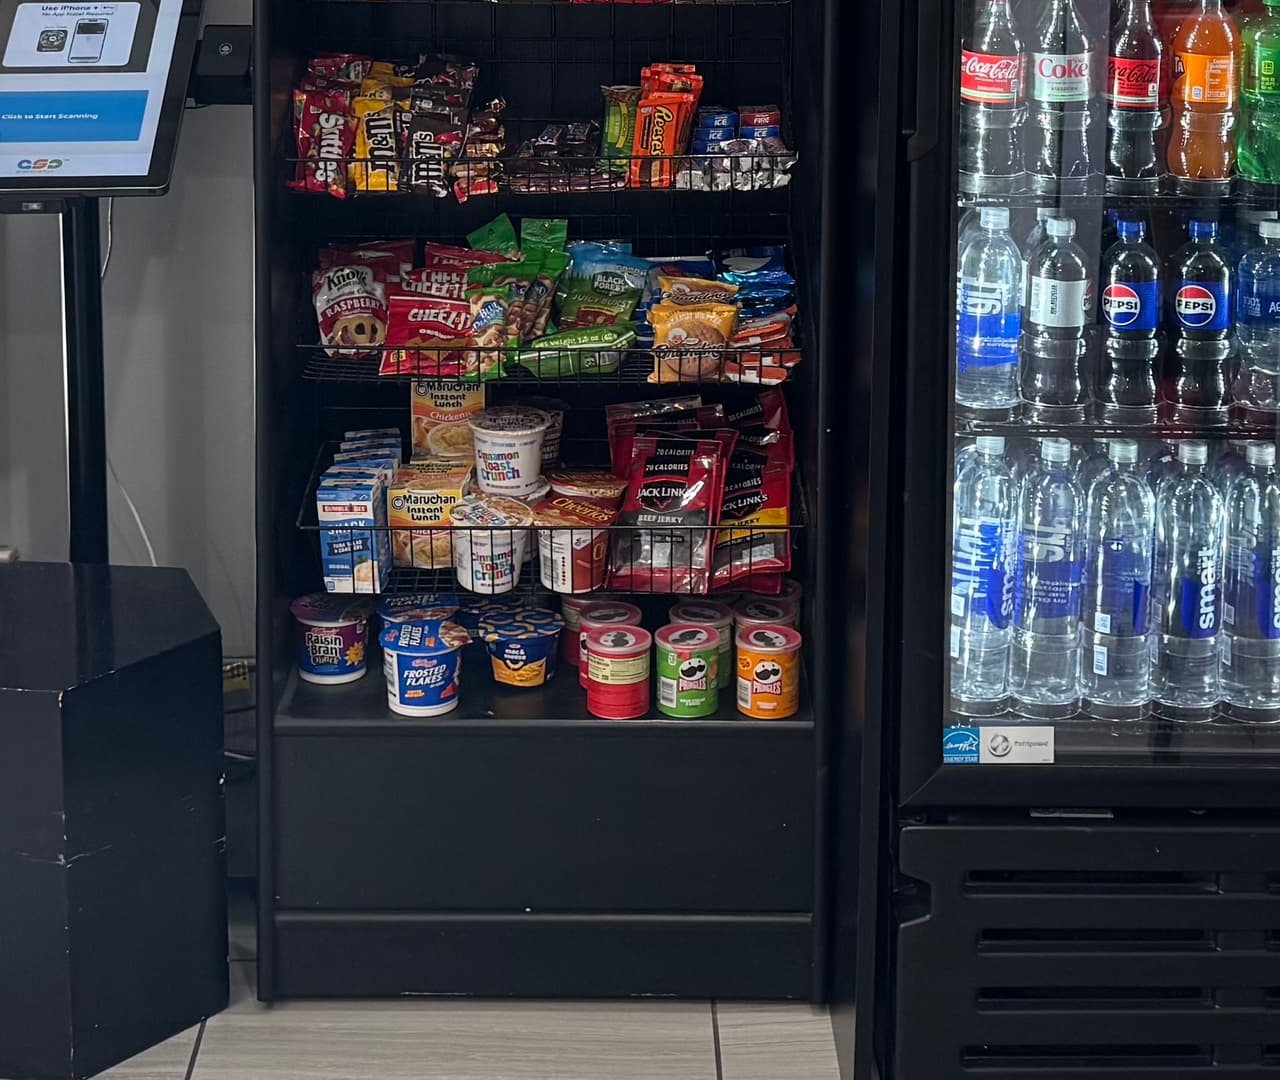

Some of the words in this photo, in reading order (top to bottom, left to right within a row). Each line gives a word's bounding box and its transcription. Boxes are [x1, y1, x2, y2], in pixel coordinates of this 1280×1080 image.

[1038, 57, 1089, 80] Coke
[714, 117, 728, 127] ICE
[709, 130, 723, 140] ICE
[754, 128, 769, 138] ICE
[597, 274, 625, 286] BLACK
[594, 282, 627, 292] FOREST
[572, 293, 602, 304] JUICY
[326, 297, 381, 318] RASPBERRY
[1103, 299, 1138, 311] PEPSI
[1177, 299, 1214, 312] PEPSI
[430, 392, 466, 401] Instant
[434, 400, 463, 408] Lunch
[477, 449, 519, 460] Cinnamon
[485, 459, 513, 471] Toast
[481, 468, 520, 483] Crunch
[403, 494, 456, 505] Maruchan
[407, 506, 444, 514] Instant
[552, 498, 613, 521] Cheerios
[411, 513, 440, 521] Lunch
[1198, 546, 1217, 630] smart
[306, 633, 343, 647] Raisin
[309, 645, 338, 657] Bran
[404, 665, 447, 679] FROSTED
[406, 674, 442, 686] FLAKES
[679, 678, 707, 691] PRINGLES
[753, 681, 782, 694] PRINGLES
